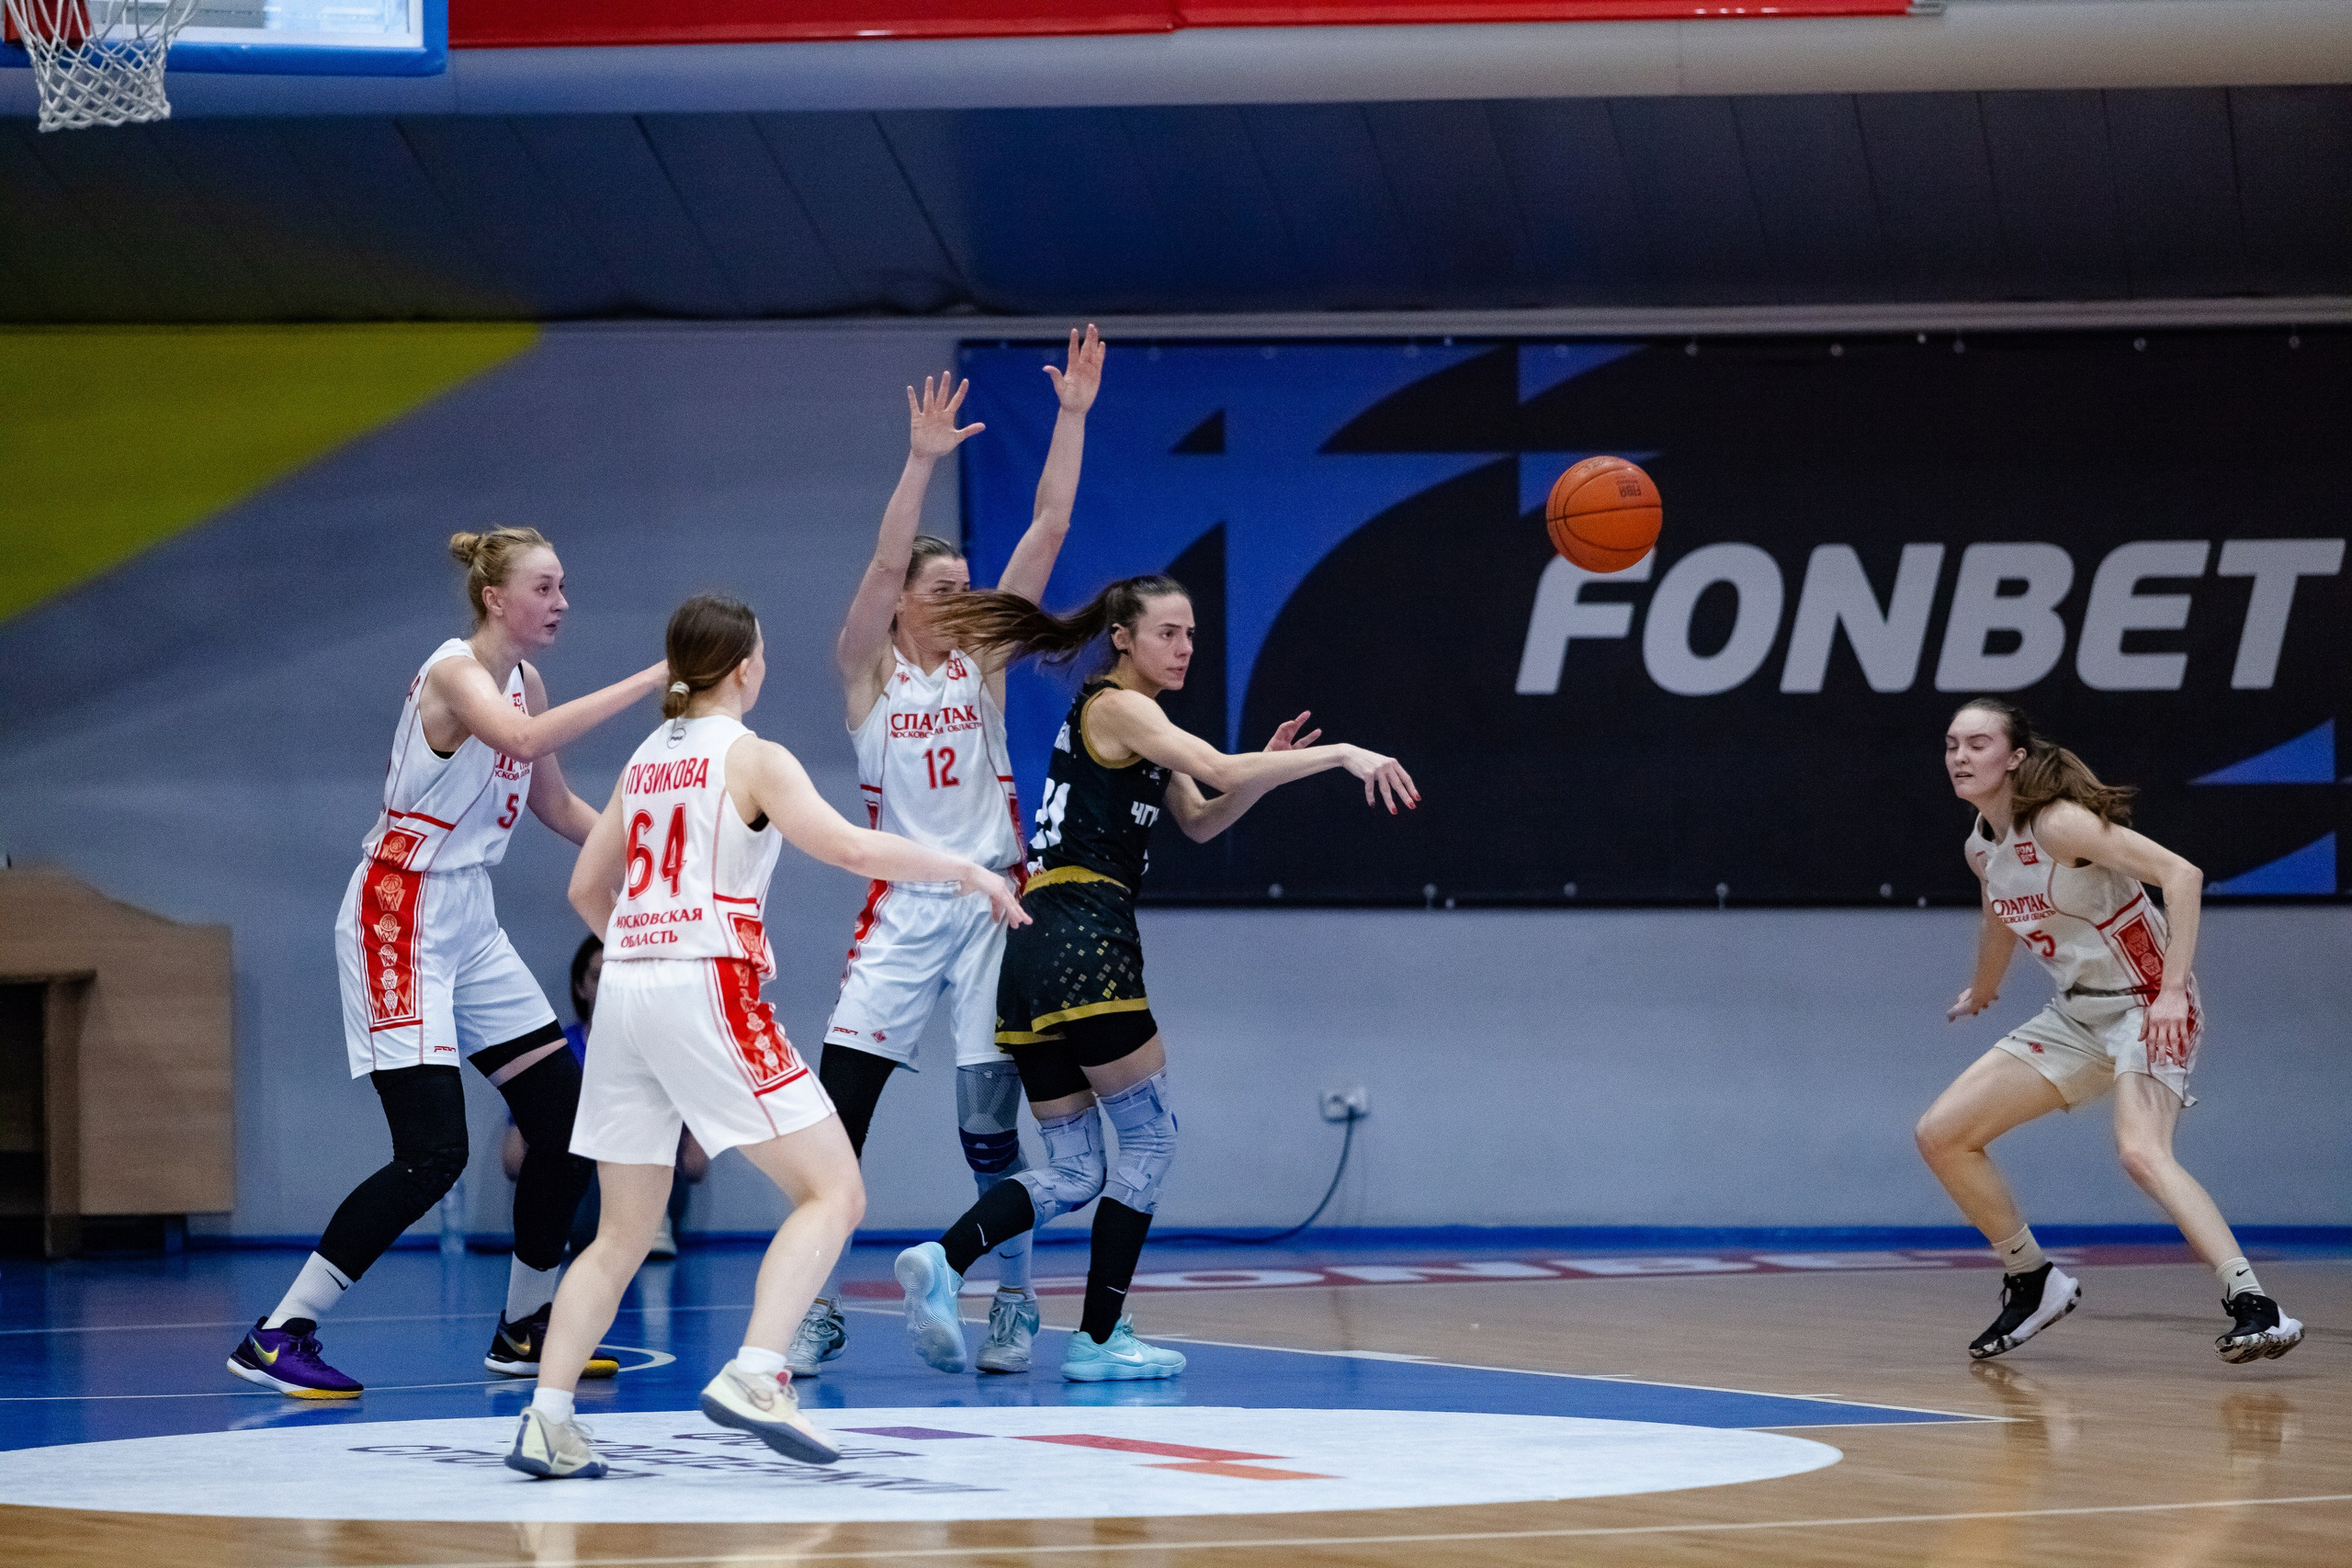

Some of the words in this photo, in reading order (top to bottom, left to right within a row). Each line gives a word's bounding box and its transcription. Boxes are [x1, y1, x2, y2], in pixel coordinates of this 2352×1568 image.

[1515, 538, 2346, 696] FONBET
[625, 757, 709, 795] ПУЗИКОВА
[922, 746, 960, 790] 12
[497, 793, 519, 829] 5
[626, 803, 687, 901] 64
[620, 930, 678, 949] ОБЛАСТЬ
